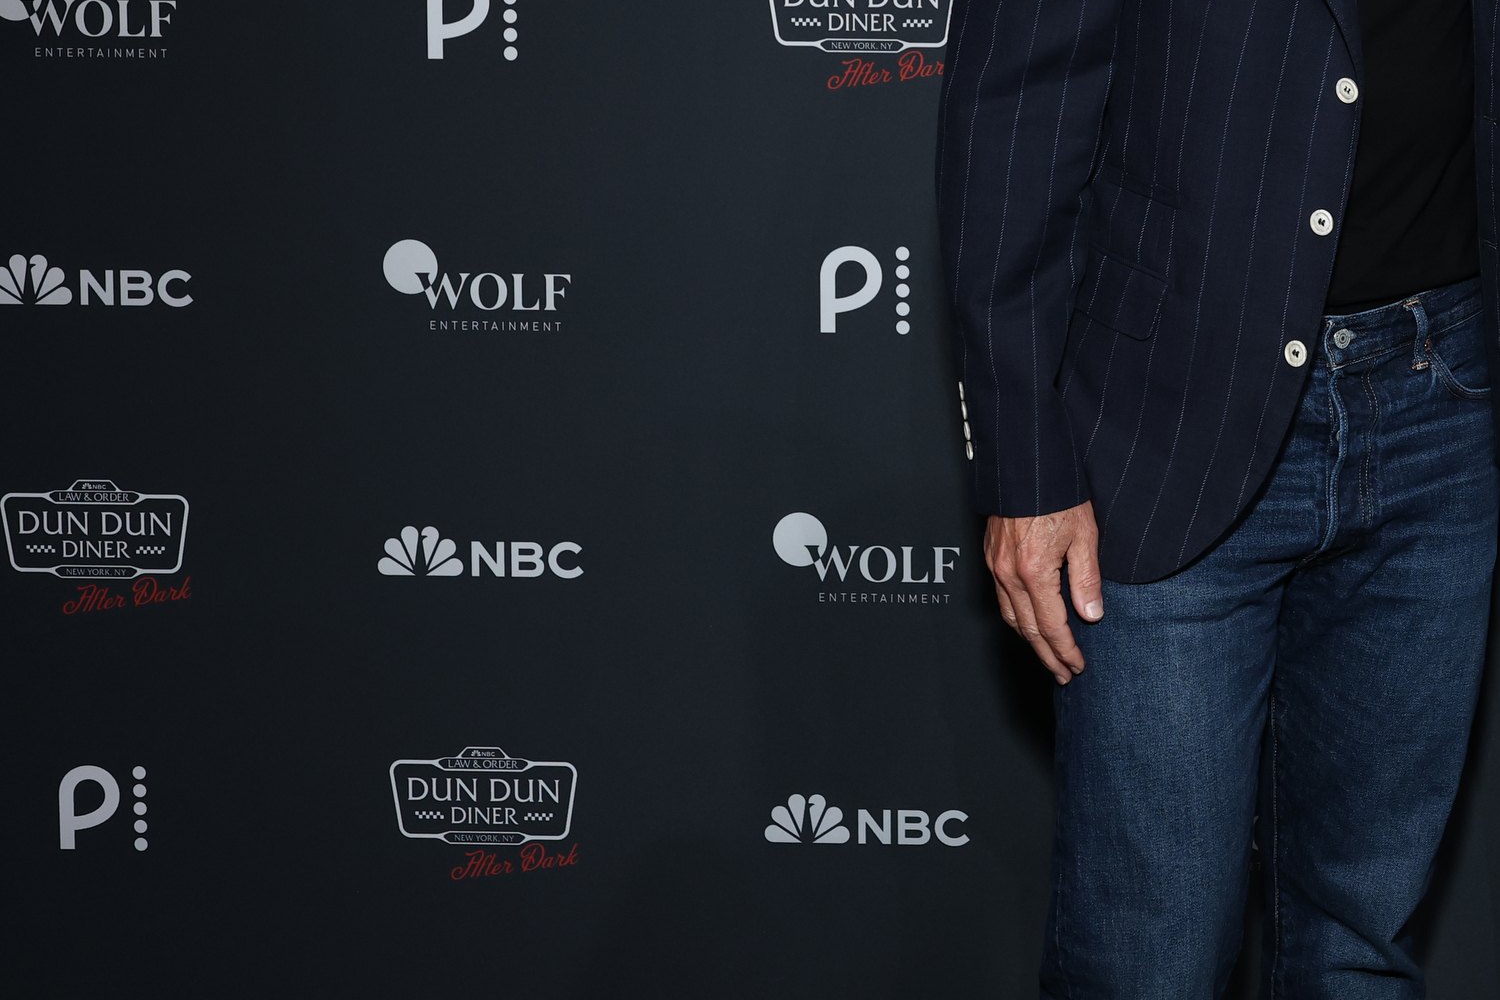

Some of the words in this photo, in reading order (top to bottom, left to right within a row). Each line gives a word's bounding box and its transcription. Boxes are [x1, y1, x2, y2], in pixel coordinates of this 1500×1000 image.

[19, 0, 176, 37] WOLF
[828, 13, 898, 32] DINER
[35, 48, 167, 58] ENTERTAINMENT
[827, 58, 893, 90] After
[898, 50, 944, 81] Dar
[80, 270, 193, 307] NBC
[415, 273, 570, 310] WOLF
[430, 321, 560, 331] ENTERTAINMENT
[59, 493, 81, 501] LAW
[84, 493, 93, 501] &
[93, 493, 129, 502] ORDER
[18, 511, 89, 535] DUN
[101, 512, 172, 536] DUN
[62, 540, 131, 558] DINER
[471, 542, 583, 578] NBC
[805, 546, 959, 583] WOLF
[62, 584, 127, 615] After
[132, 576, 192, 606] Dark
[819, 593, 949, 603] ENTERTAINMENT
[448, 760, 470, 768] LAW
[473, 760, 482, 768] &
[482, 760, 518, 769] ORDER
[407, 778, 478, 802] DUN
[490, 779, 560, 803] DUN
[451, 807, 519, 825] DINER
[858, 810, 969, 846] NBC
[451, 849, 515, 880] After
[520, 842, 579, 872] Dark
